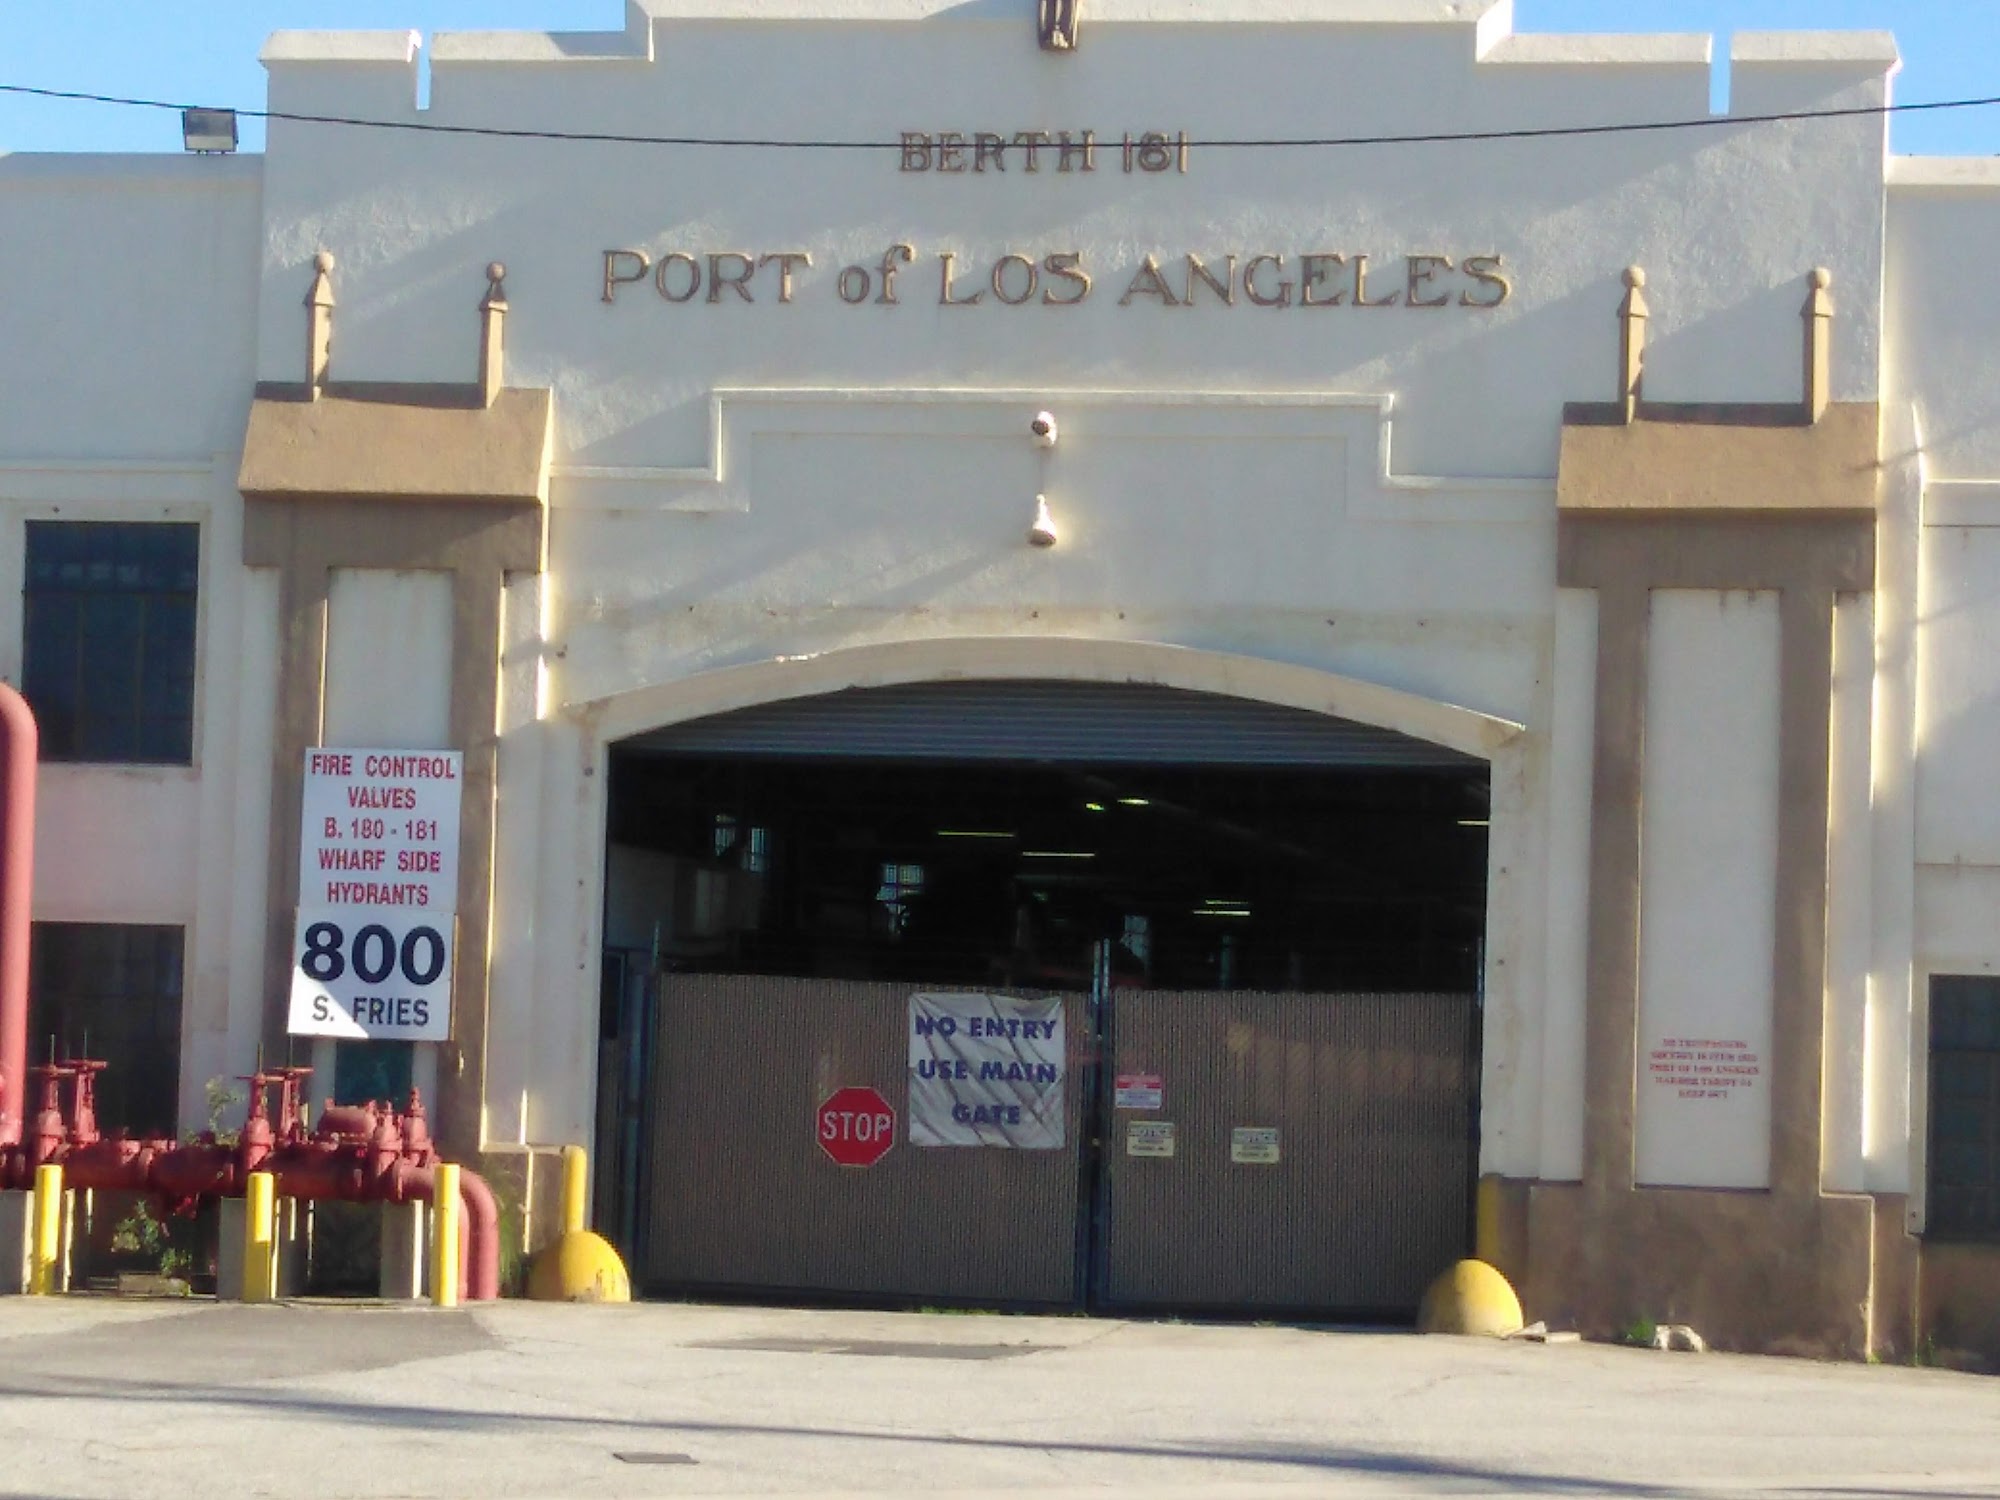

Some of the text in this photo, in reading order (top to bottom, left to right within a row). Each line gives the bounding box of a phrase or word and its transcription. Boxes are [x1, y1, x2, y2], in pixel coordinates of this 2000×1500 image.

[899, 130, 1188, 173] BERTH 181
[601, 243, 1513, 308] PORT of LOS ANGELES
[311, 754, 456, 779] FIRE CONTROL
[348, 786, 416, 810] VALVES
[324, 816, 343, 839] B.
[351, 817, 385, 839] 180
[405, 819, 438, 841] 181
[318, 847, 441, 872] WHARF SIDE
[327, 881, 429, 906] HYDRANTS
[301, 921, 445, 985] 800
[312, 995, 429, 1026] S. FRIES
[915, 1014, 1057, 1039] NO ENTRY
[918, 1059, 1057, 1083] USE MAIN
[822, 1110, 892, 1142] STOP
[952, 1103, 1021, 1125] GATE
